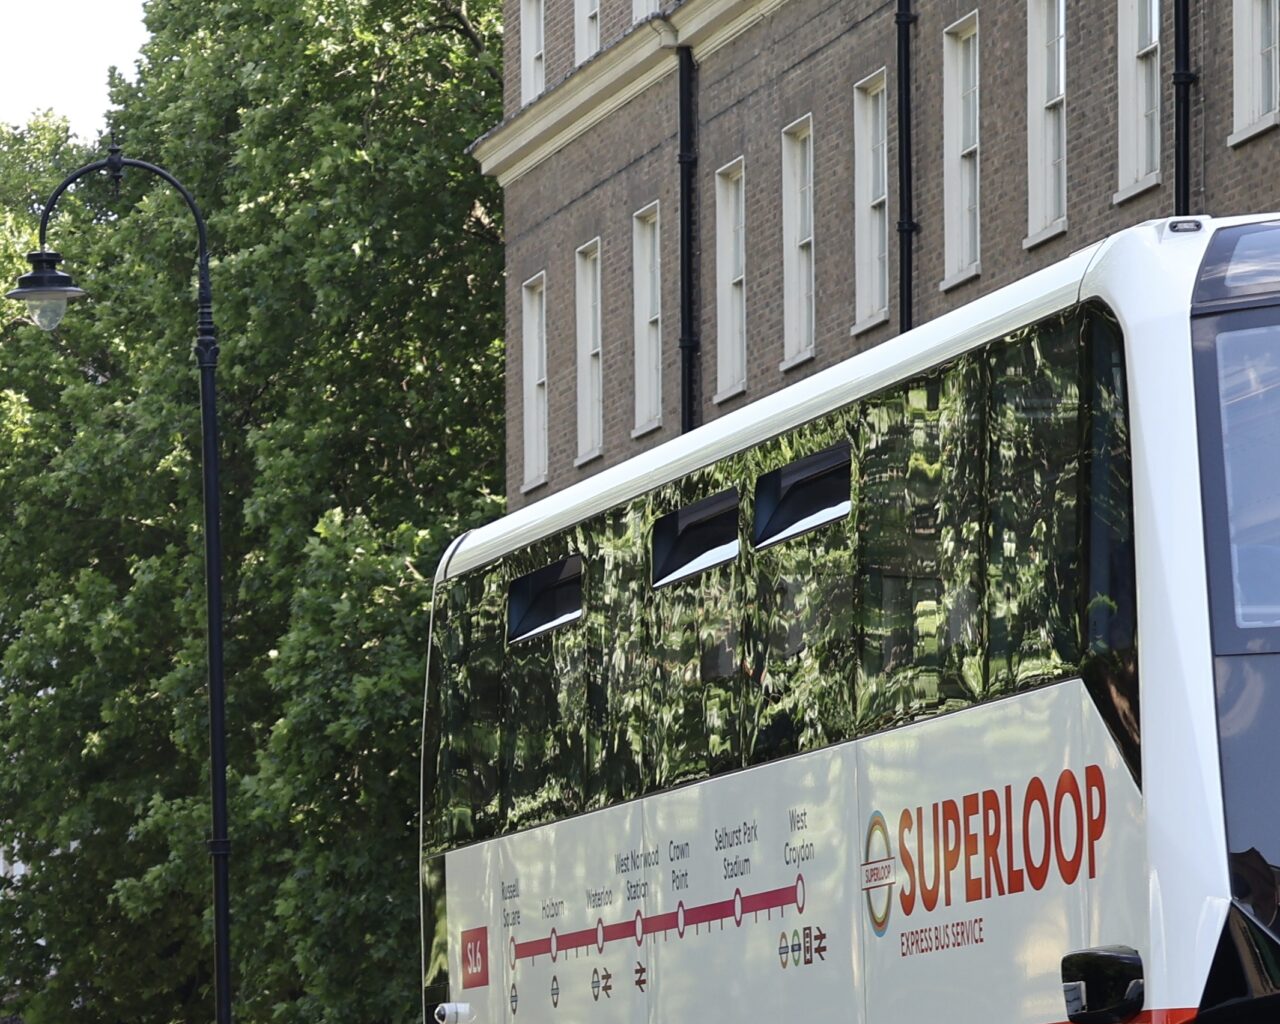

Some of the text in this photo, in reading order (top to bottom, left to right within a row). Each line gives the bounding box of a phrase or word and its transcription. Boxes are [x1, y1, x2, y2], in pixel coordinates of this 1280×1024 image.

[788, 808, 808, 832] West
[714, 819, 758, 851] Selhurst Park
[898, 764, 1107, 916] SUPERLOOP
[614, 844, 659, 875] West Norwood
[668, 840, 690, 862] Crown
[784, 838, 815, 869] Croydon
[671, 869, 689, 892] Point
[723, 855, 751, 880] Stadium
[865, 864, 892, 884] SUPERLOOP
[626, 878, 649, 901] Station
[900, 917, 984, 957] EXPRESS BUS SERVICE
[467, 940, 482, 975] SL6
